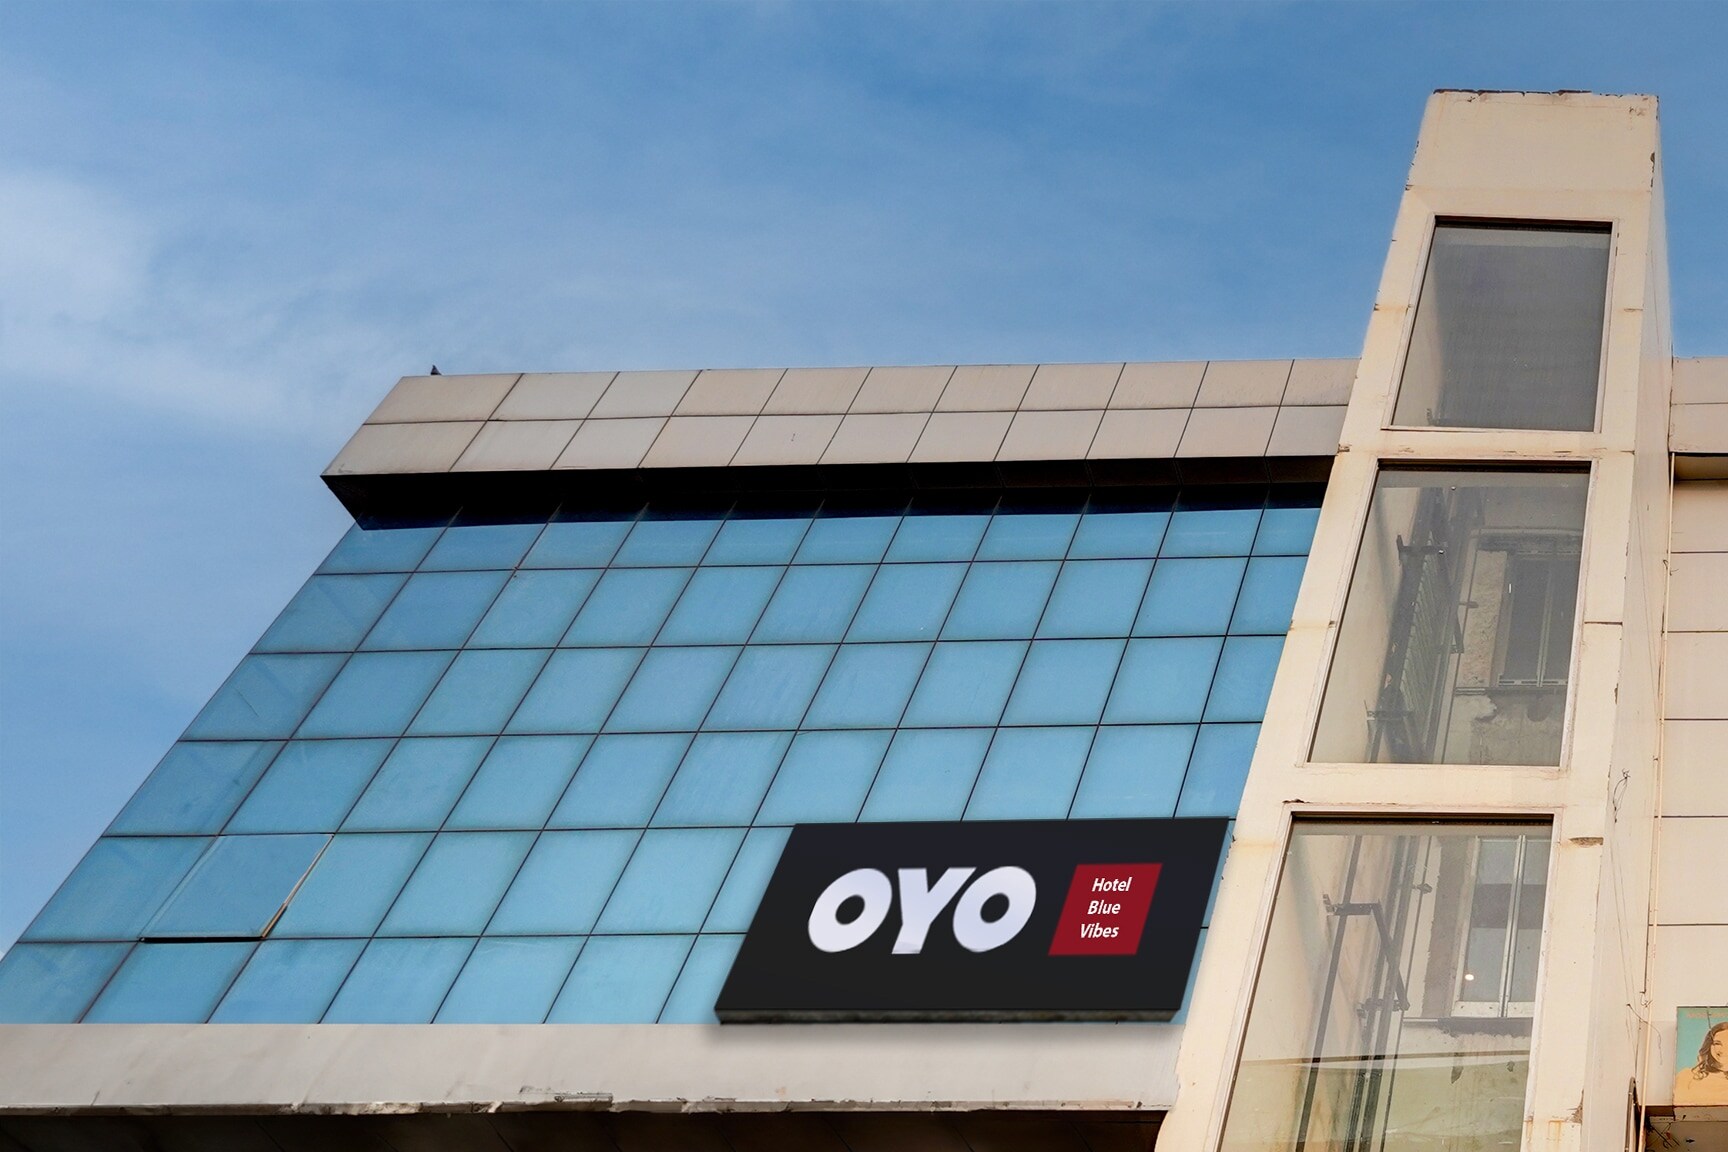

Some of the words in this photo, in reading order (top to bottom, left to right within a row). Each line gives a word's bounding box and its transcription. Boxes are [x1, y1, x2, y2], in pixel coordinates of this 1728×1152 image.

[1092, 876, 1132, 892] Hotel
[807, 865, 1037, 954] OYO
[1087, 900, 1121, 916] Blue
[1080, 923, 1119, 939] Vibes
